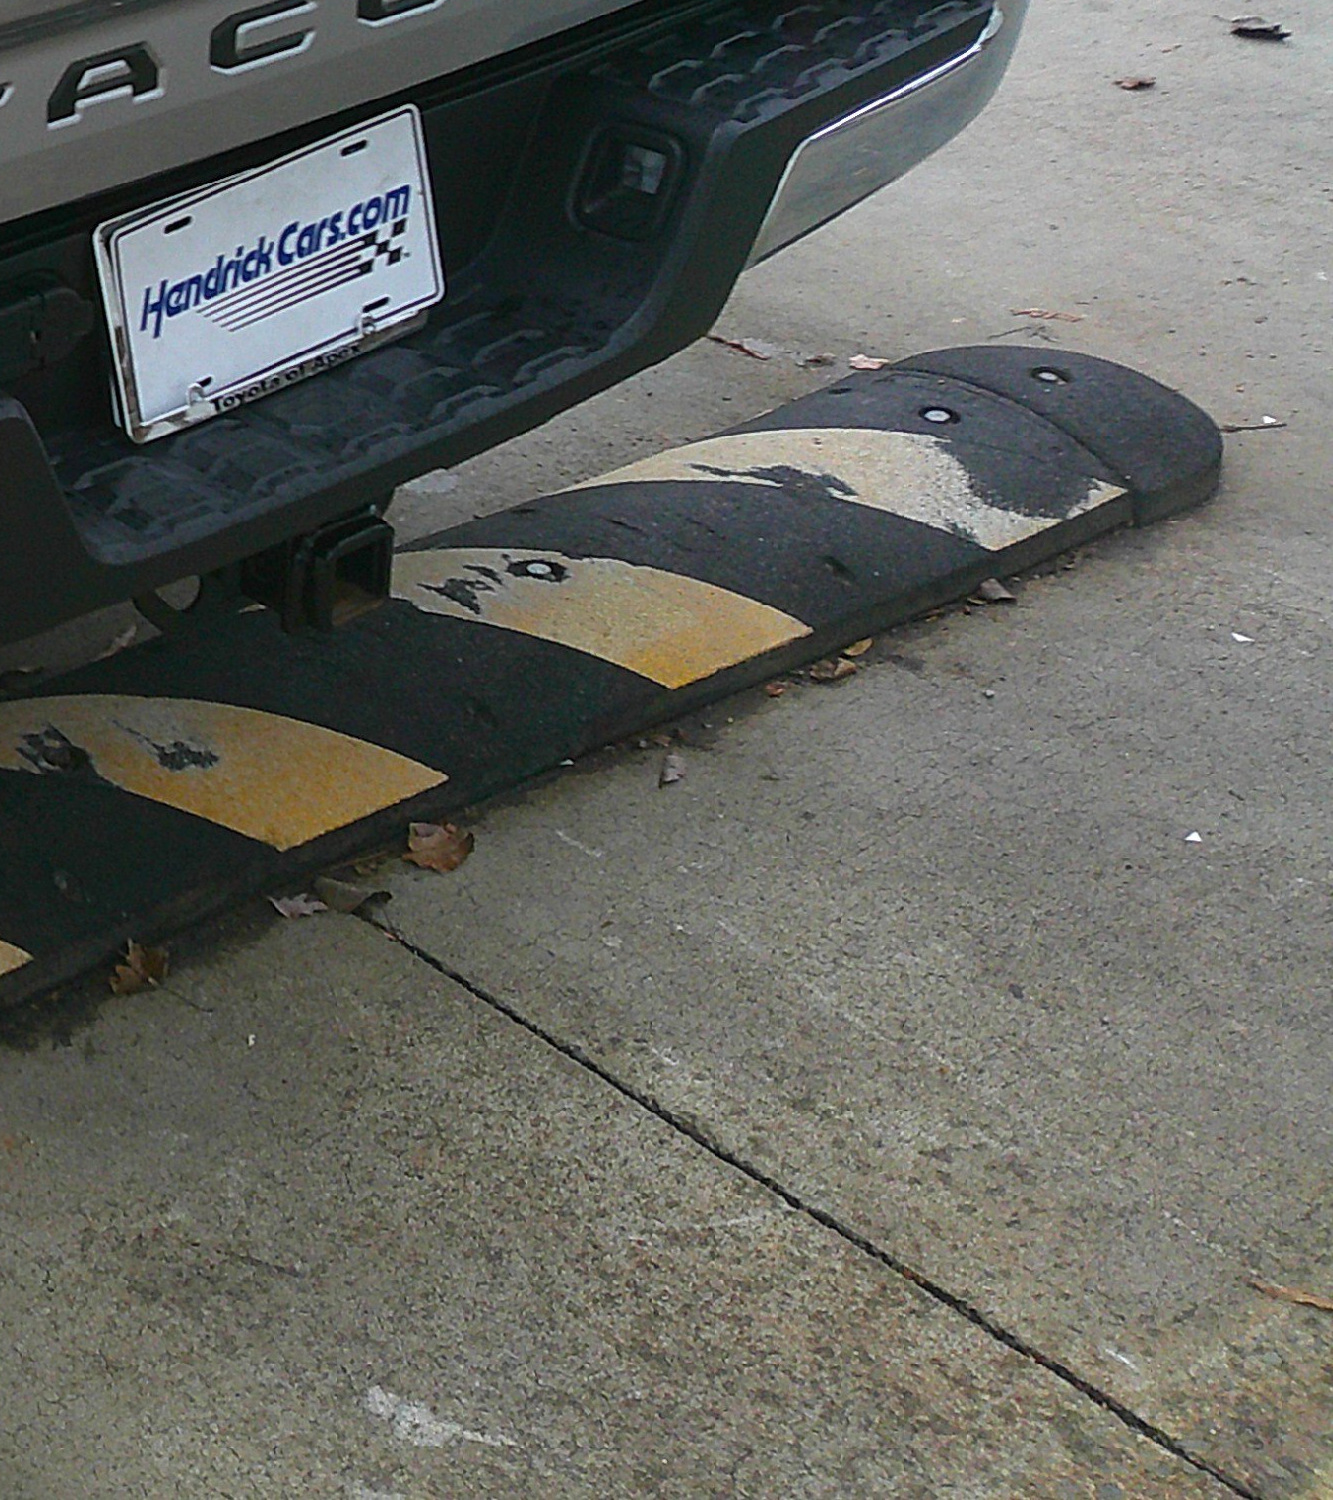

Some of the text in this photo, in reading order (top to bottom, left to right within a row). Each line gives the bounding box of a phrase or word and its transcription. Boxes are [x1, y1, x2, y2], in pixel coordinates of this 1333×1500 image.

[210, 342, 361, 412] Toyota of Apex
